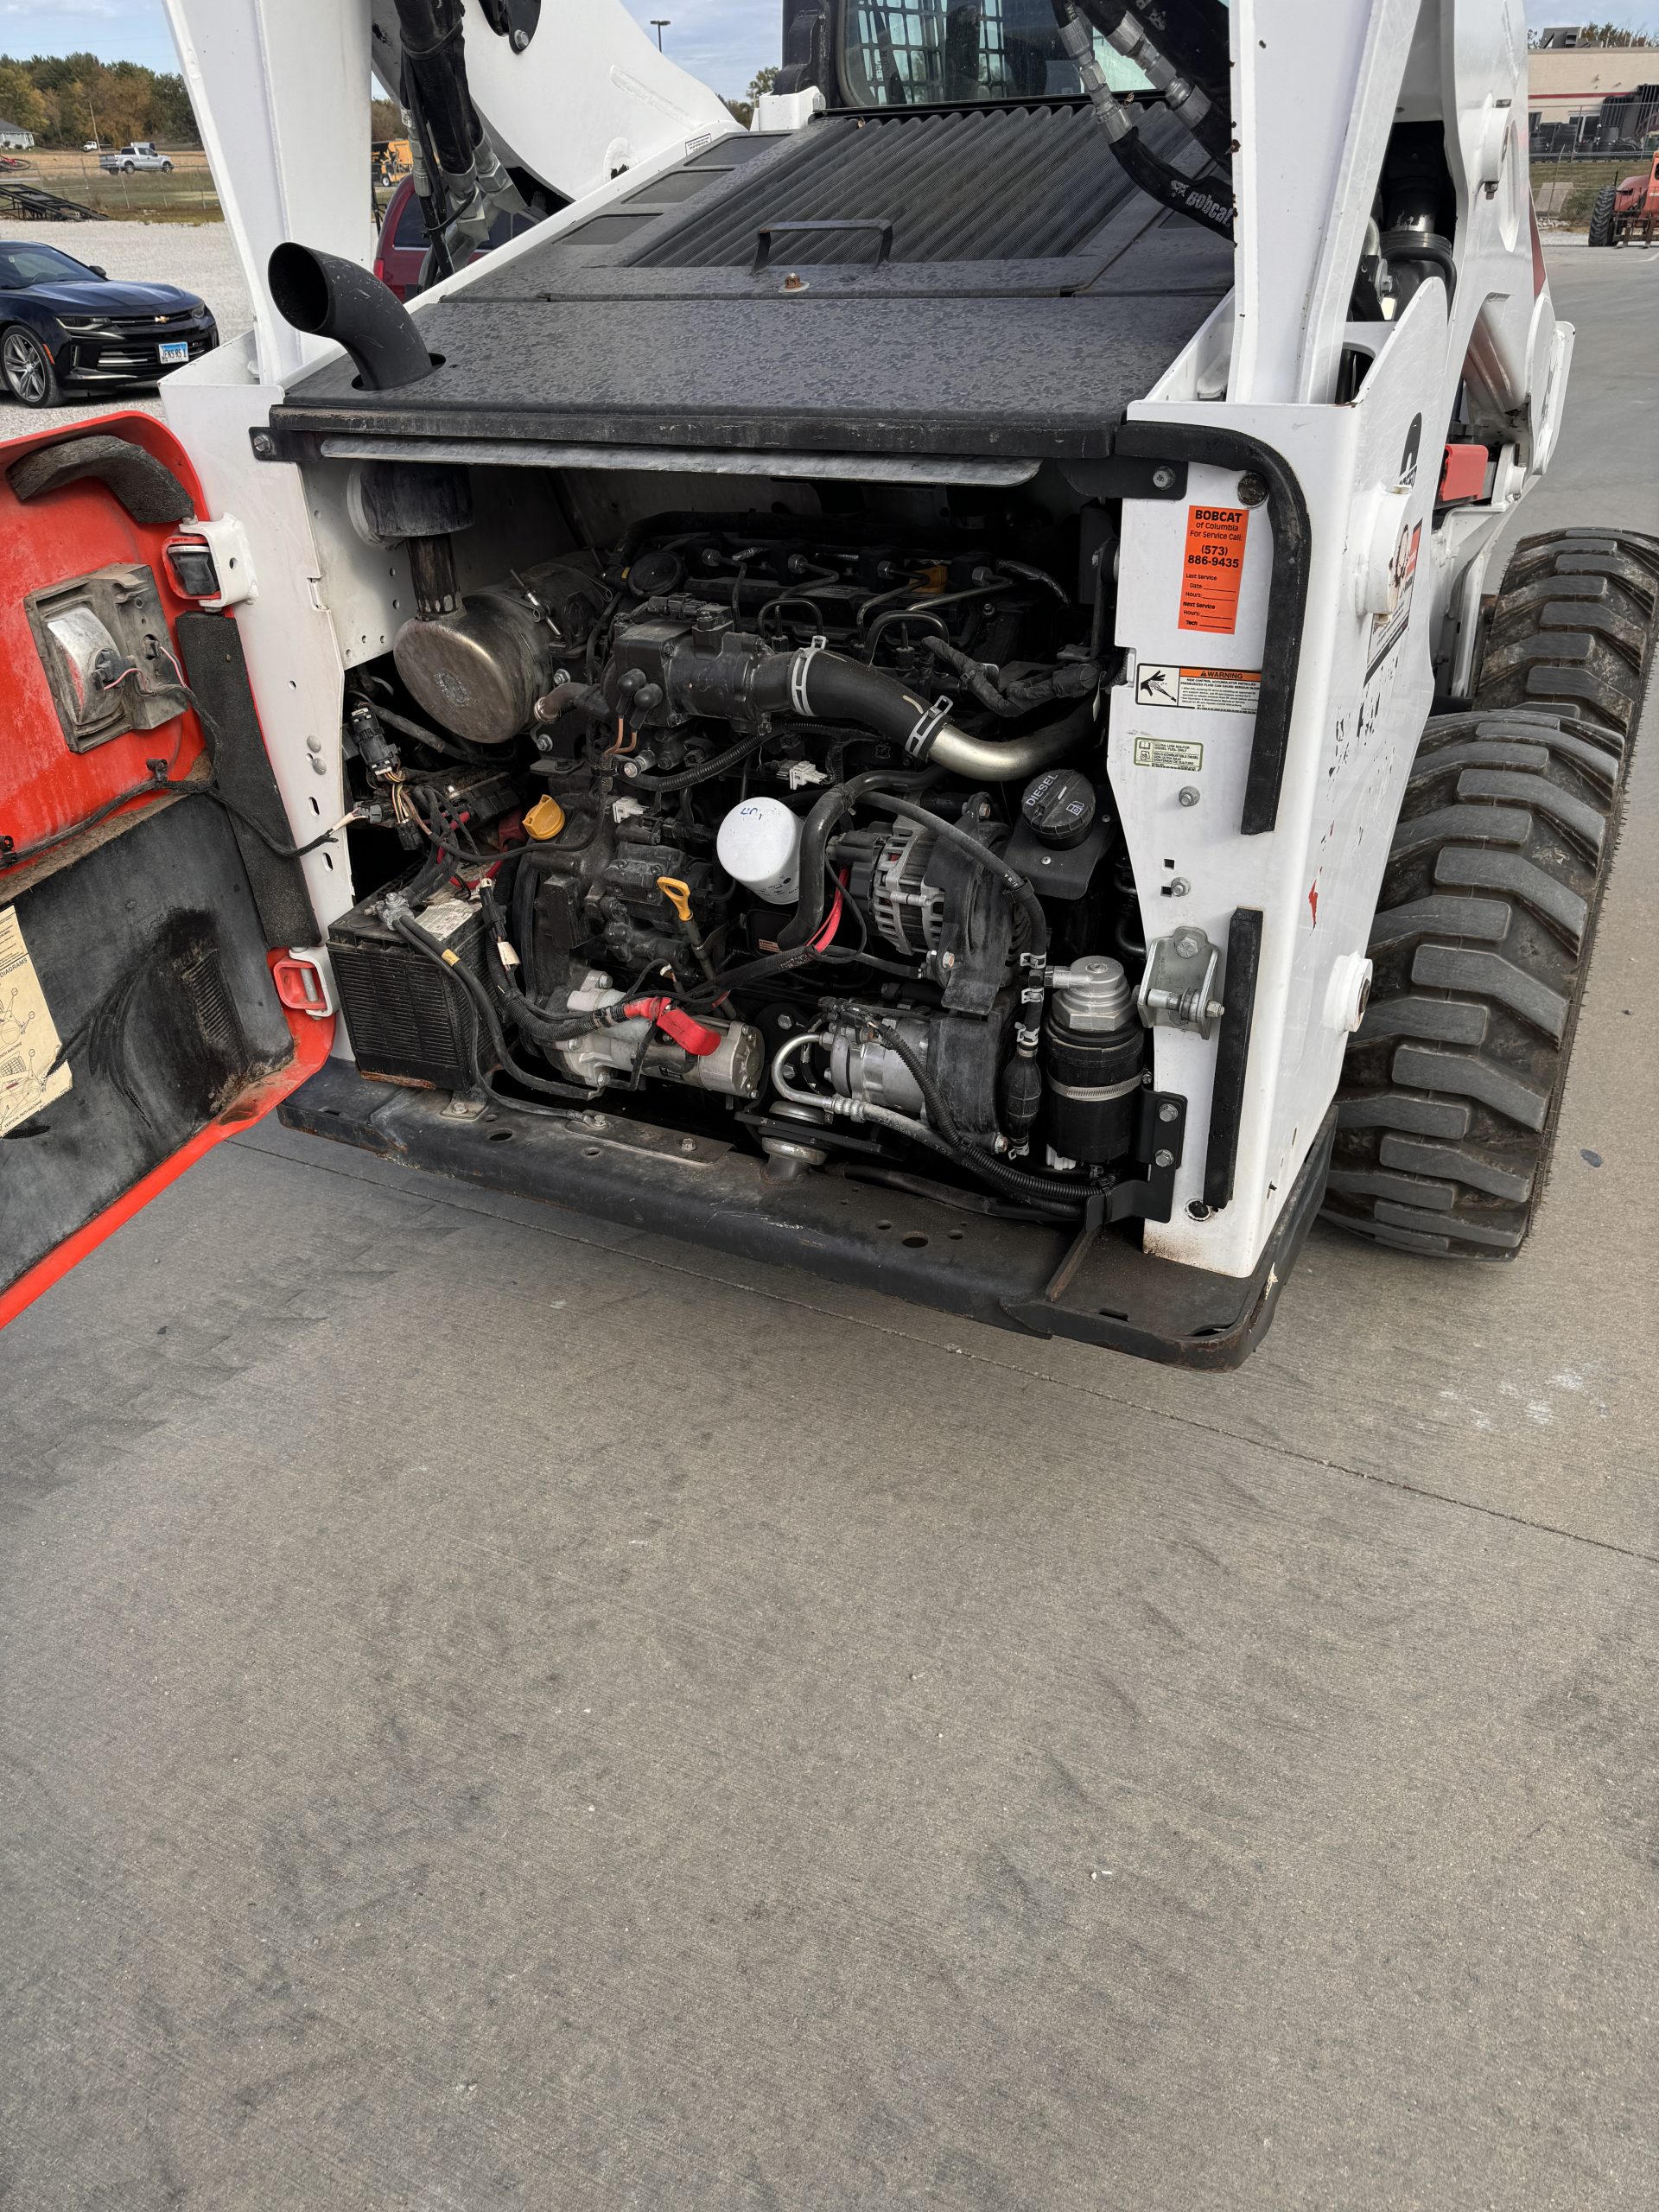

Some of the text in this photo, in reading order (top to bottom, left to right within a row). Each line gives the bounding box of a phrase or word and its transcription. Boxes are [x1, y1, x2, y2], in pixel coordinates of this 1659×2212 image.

[1185, 191, 1234, 226] Bobcat
[1195, 510, 1243, 523] BOBCAT
[1205, 523, 1238, 531] Columbia
[1203, 531, 1227, 540] Service
[1201, 544, 1228, 556] (573)
[1187, 555, 1239, 568] 886-9435
[1025, 774, 1058, 806] DIESEL
[0, 957, 28, 977] DIAGRAMS
[4, 1116, 19, 1128] VERTICAL
